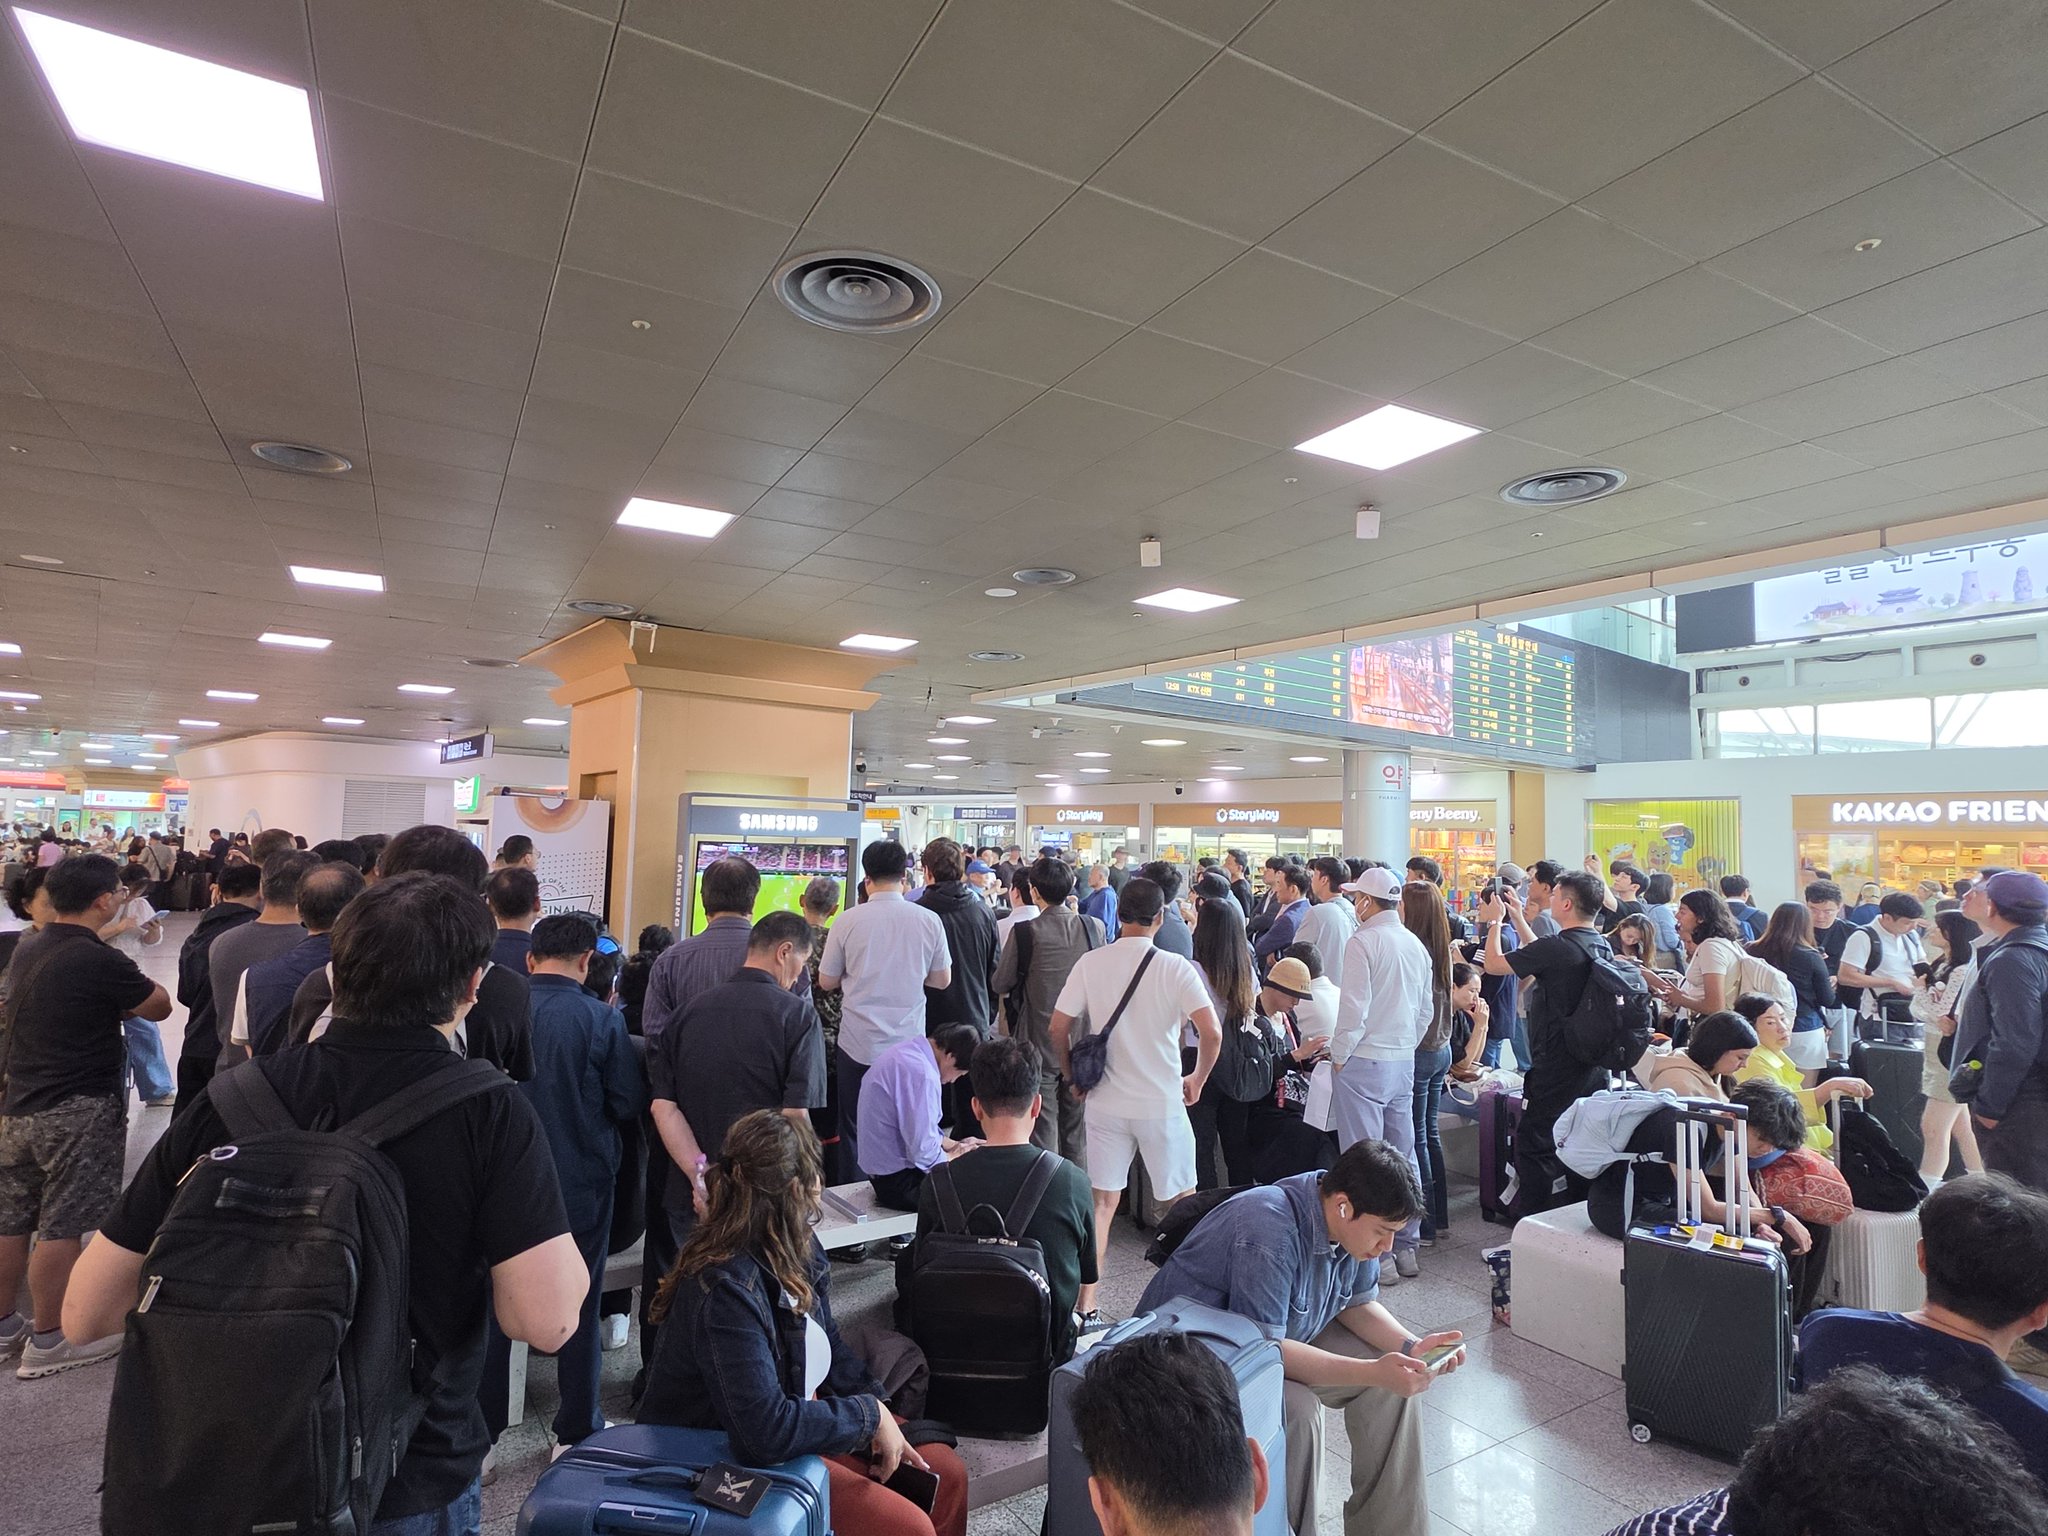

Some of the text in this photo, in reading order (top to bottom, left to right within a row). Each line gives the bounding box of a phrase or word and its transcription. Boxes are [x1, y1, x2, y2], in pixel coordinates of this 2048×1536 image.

[1382, 765, 1411, 790] 약
[1228, 808, 1280, 823] StoryWay
[1409, 809, 1434, 823] eny
[1832, 800, 2048, 823] KAKAO FRIEN
[739, 813, 819, 832] SAMSUNG
[674, 854, 684, 927] SAMSUNG
[542, 904, 580, 915] GINAL
